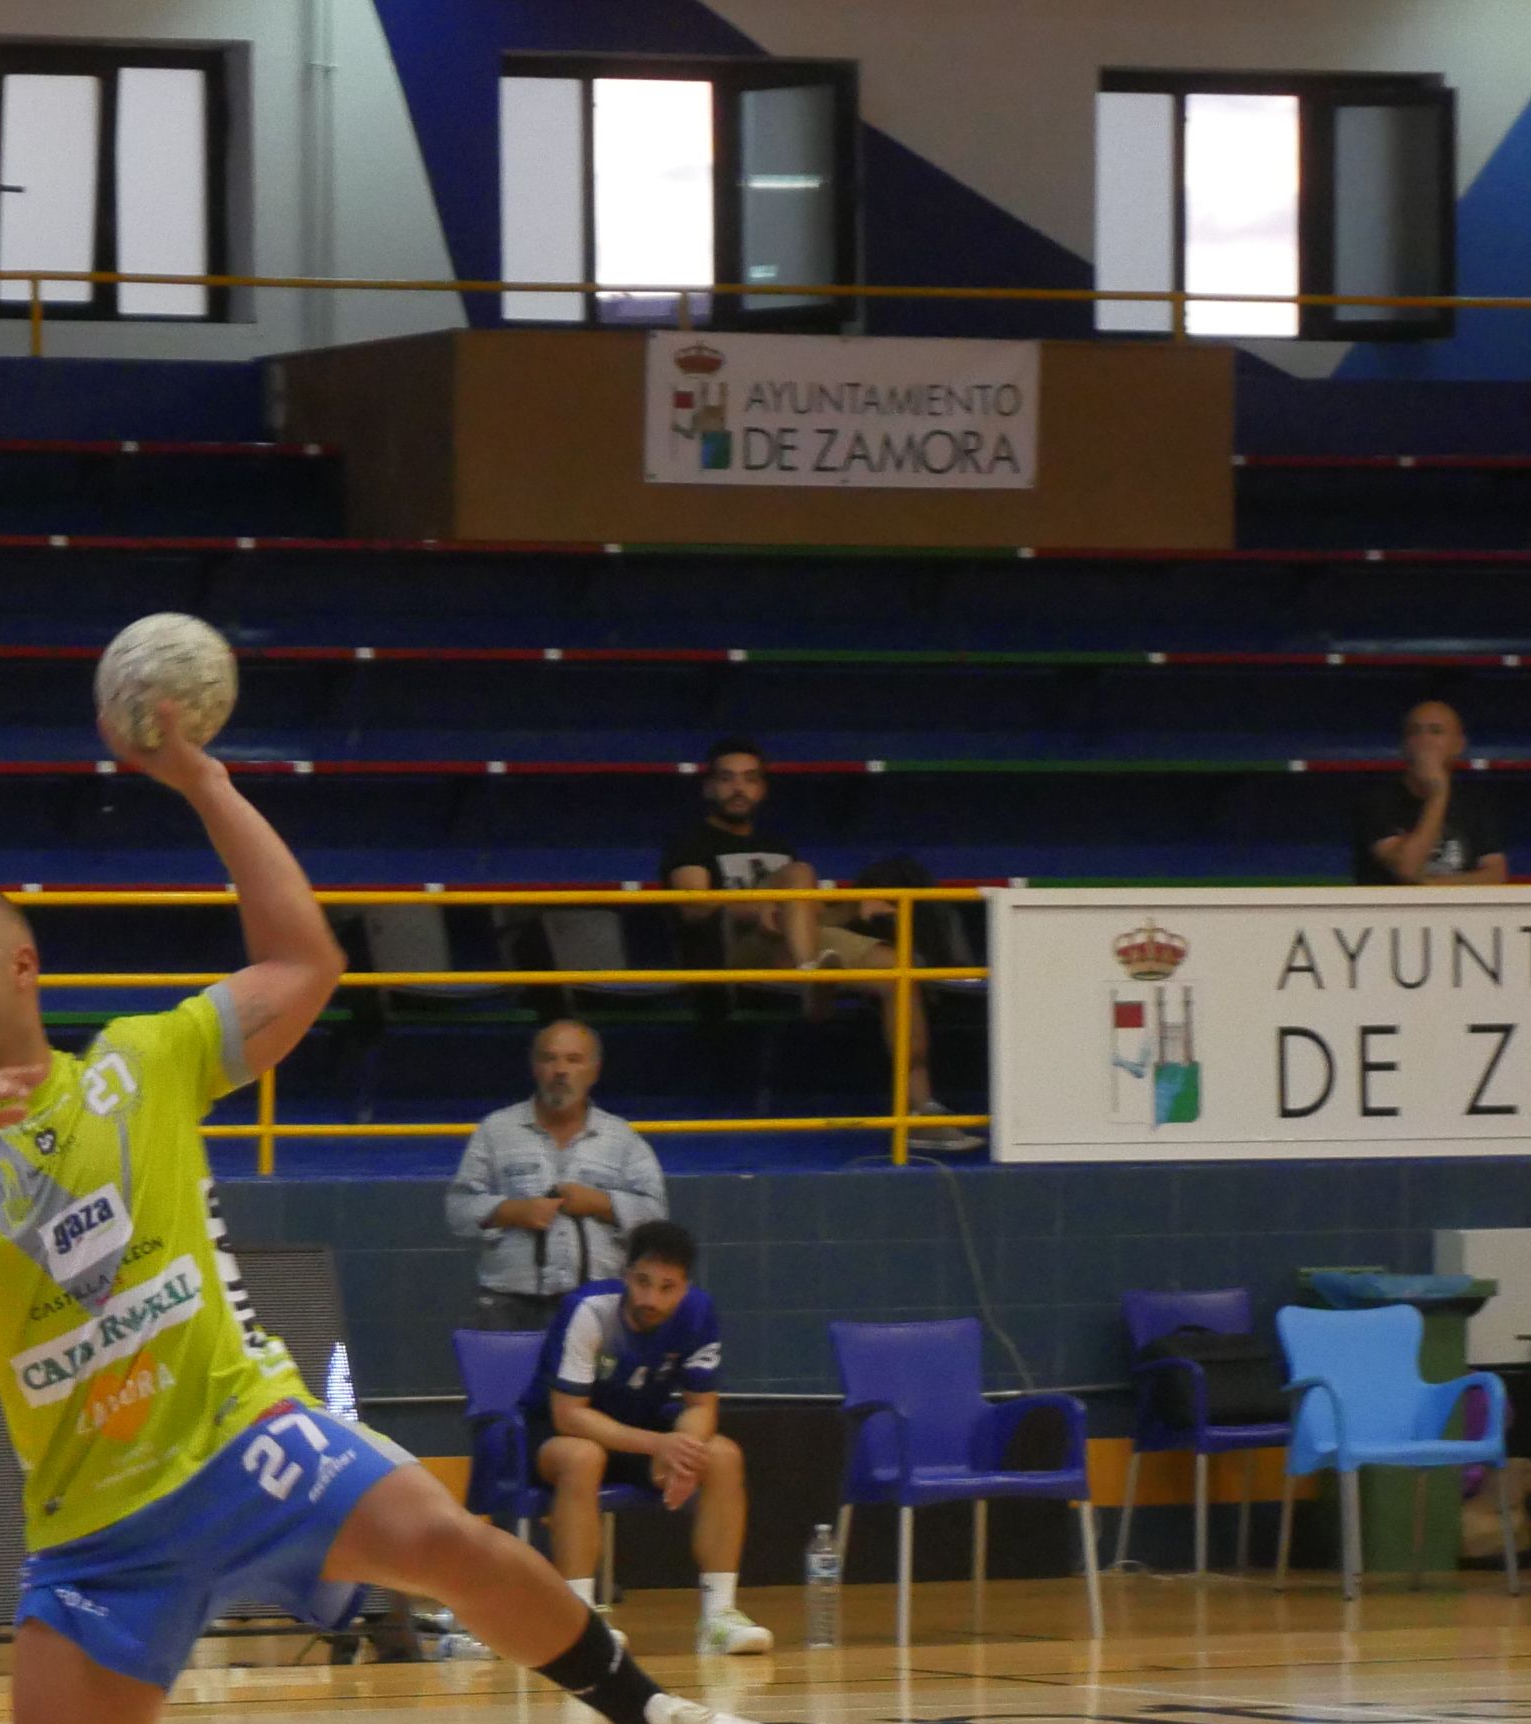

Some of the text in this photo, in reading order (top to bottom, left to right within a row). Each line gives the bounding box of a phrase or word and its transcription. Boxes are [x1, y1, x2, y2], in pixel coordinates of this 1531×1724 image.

[743, 380, 1023, 418] AYUNTAMIENTO
[742, 426, 1022, 475] DE ZAMORA
[80, 1051, 138, 1116] 27
[1276, 1023, 1402, 1118] DE
[52, 1195, 115, 1256] gaza
[242, 1412, 329, 1500] 27
